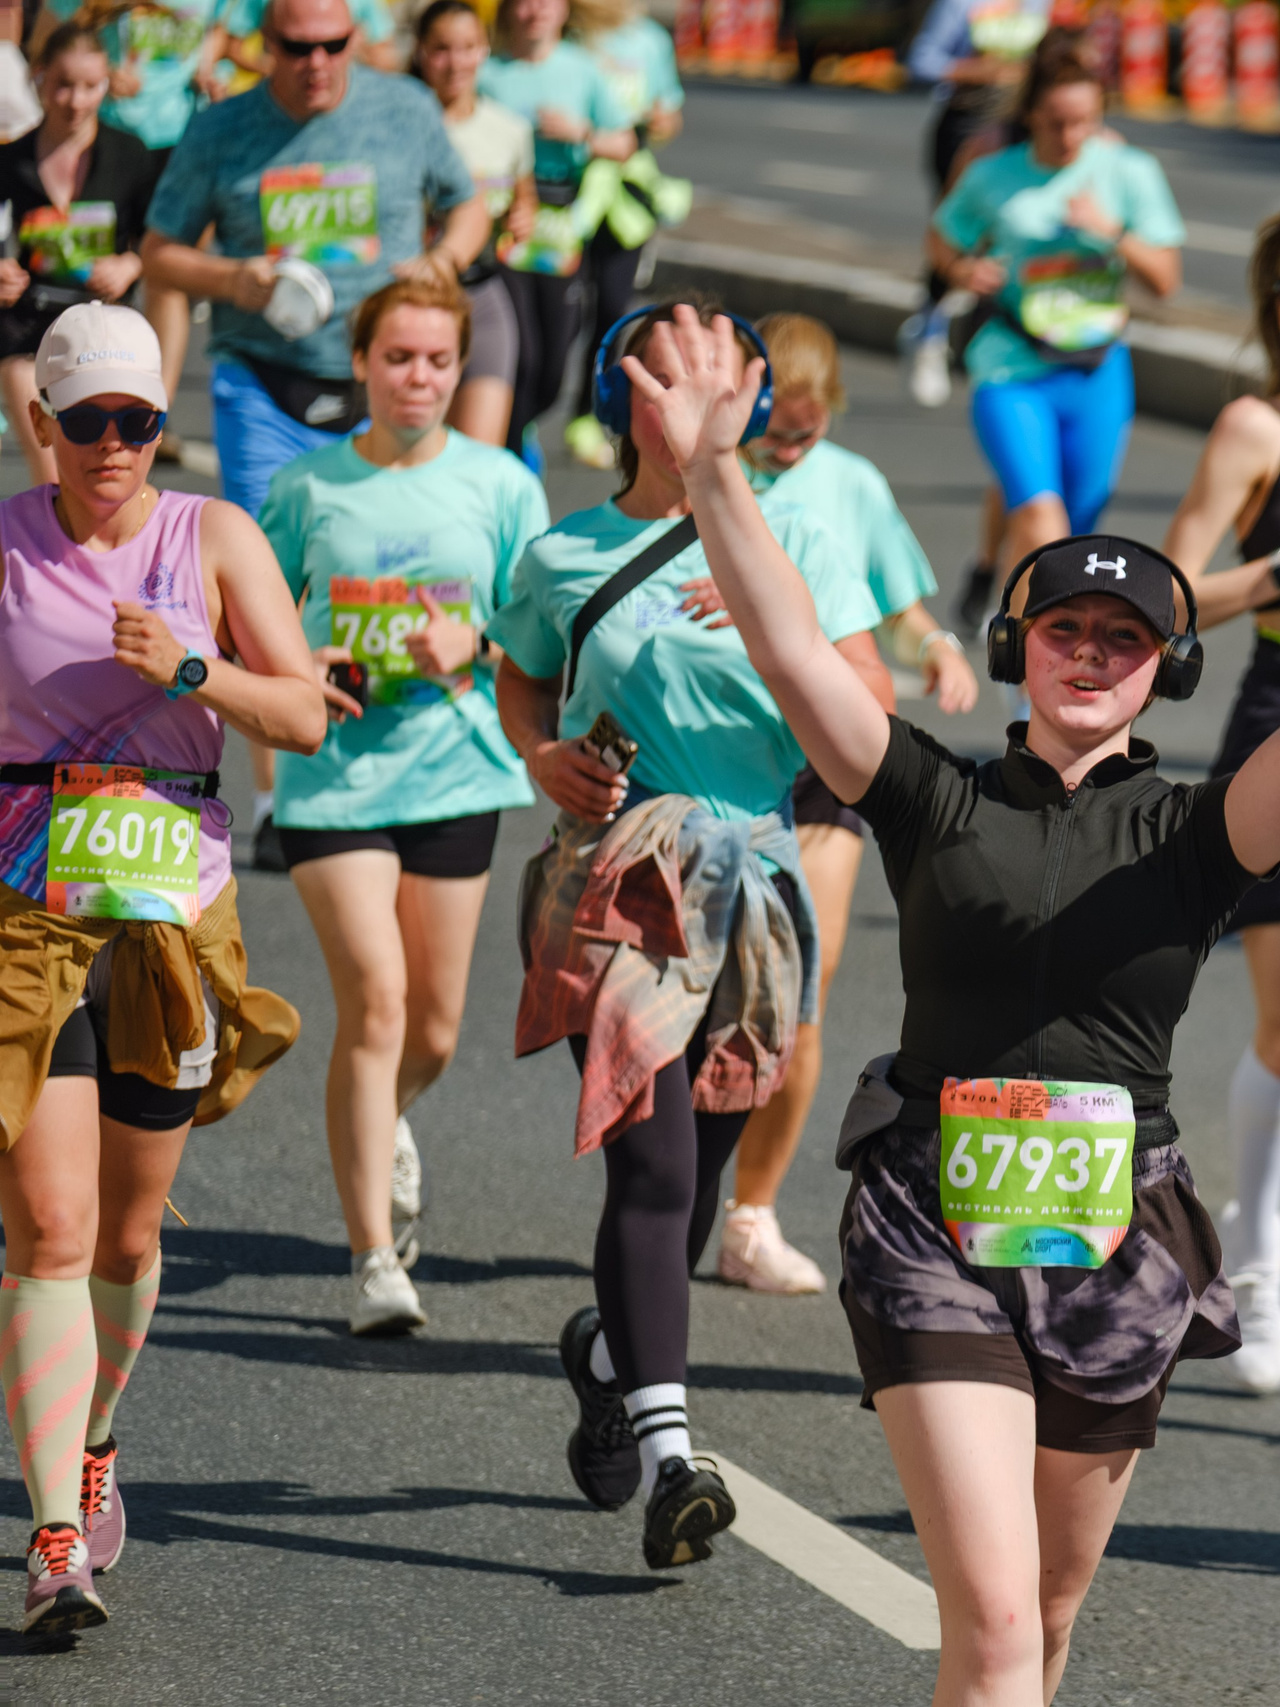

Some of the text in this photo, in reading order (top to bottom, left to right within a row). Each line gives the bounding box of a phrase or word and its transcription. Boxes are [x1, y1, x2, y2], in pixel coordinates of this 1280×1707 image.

[56, 807, 195, 866] 76019
[54, 865, 194, 885] ФЕСТИВАЛЬ ДВИЖЕНИЯ
[950, 1094, 998, 1103] 23/08
[1079, 1097, 1088, 1105] 5
[946, 1132, 1127, 1194] 67937
[947, 1202, 1124, 1217] ФЕСТИВАЛЬ ДВИЖЕНИЯ
